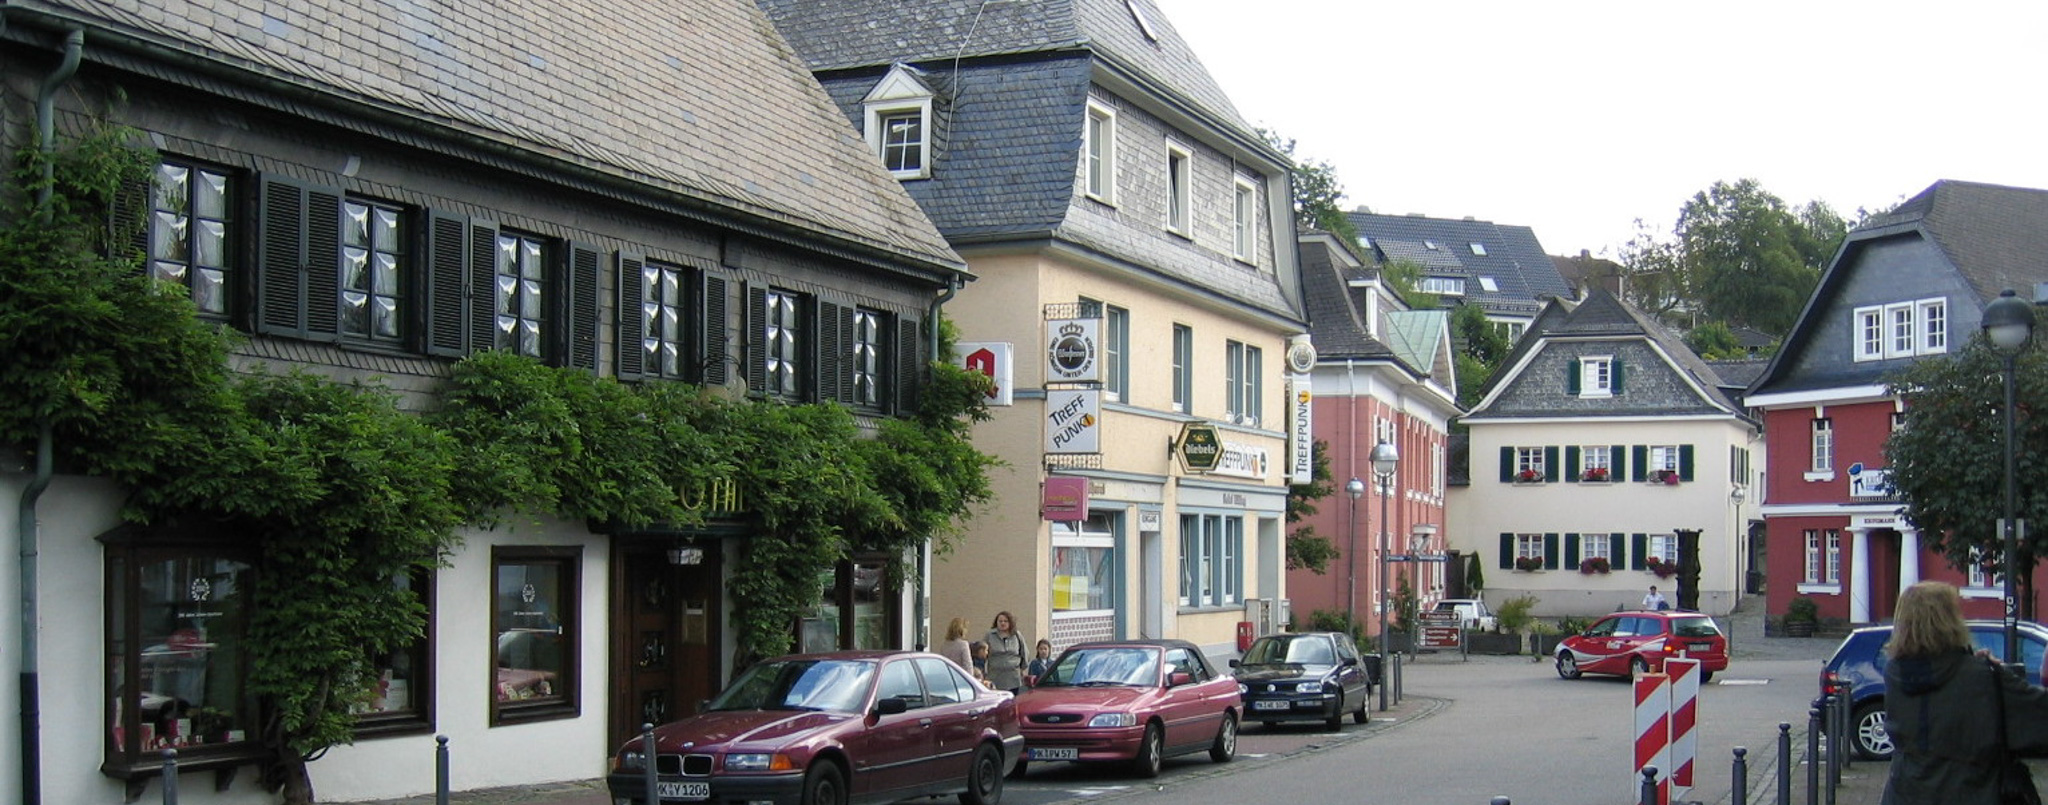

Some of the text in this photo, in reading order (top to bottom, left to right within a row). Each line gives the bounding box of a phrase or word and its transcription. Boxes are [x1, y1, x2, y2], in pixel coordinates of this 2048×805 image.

[1049, 394, 1085, 426] TREFF
[1053, 413, 1092, 448] PUNKT
[1296, 391, 1309, 474] TREFFPUNKT
[674, 785, 681, 796] Y
[682, 784, 708, 796] 1206
